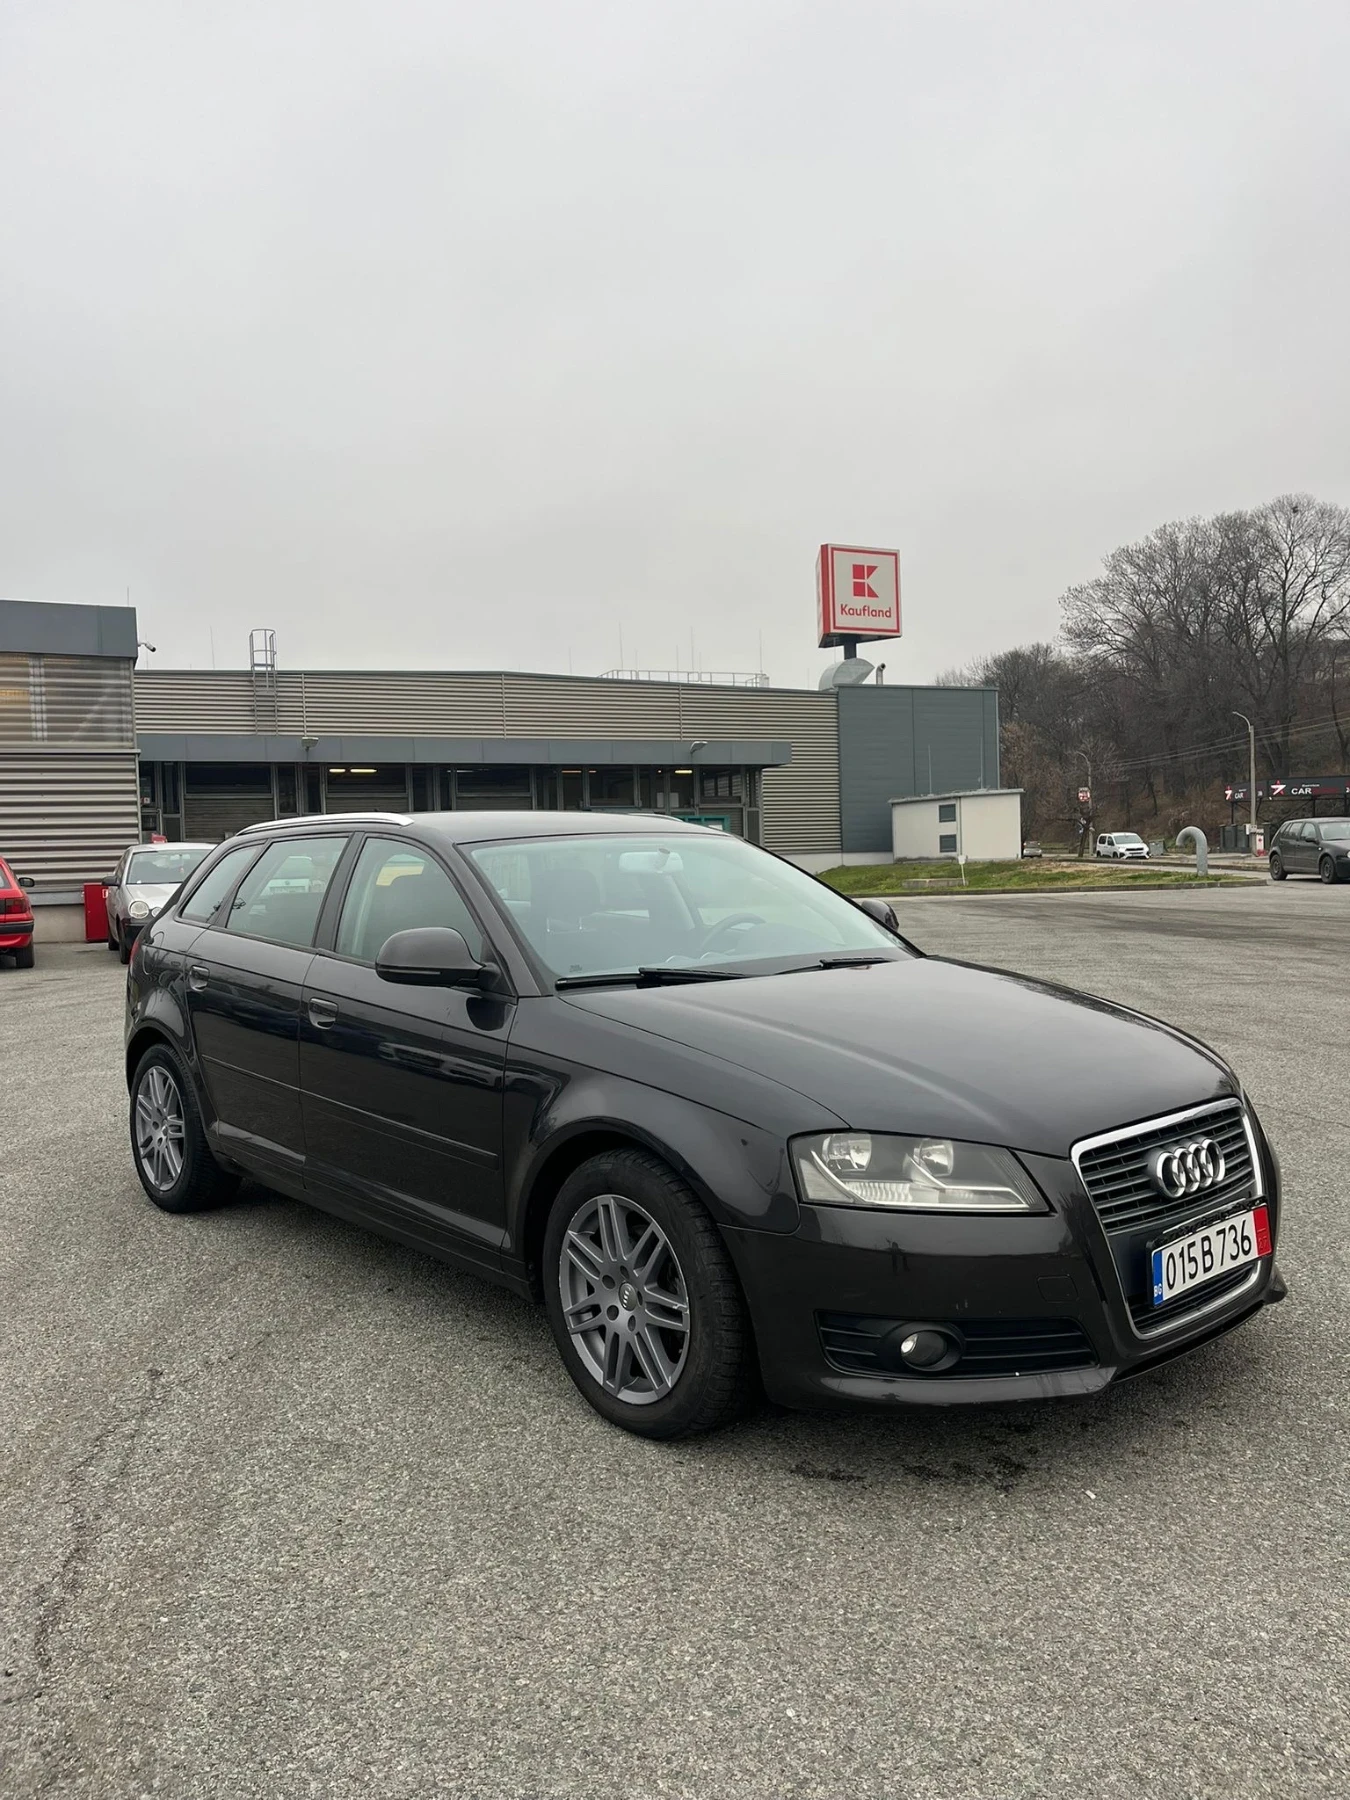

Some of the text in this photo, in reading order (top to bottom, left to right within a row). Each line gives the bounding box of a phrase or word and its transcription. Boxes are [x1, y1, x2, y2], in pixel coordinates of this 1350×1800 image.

[840, 603, 892, 618] Kaufland
[1291, 787, 1312, 795] CAR
[1153, 1283, 1163, 1297] BG
